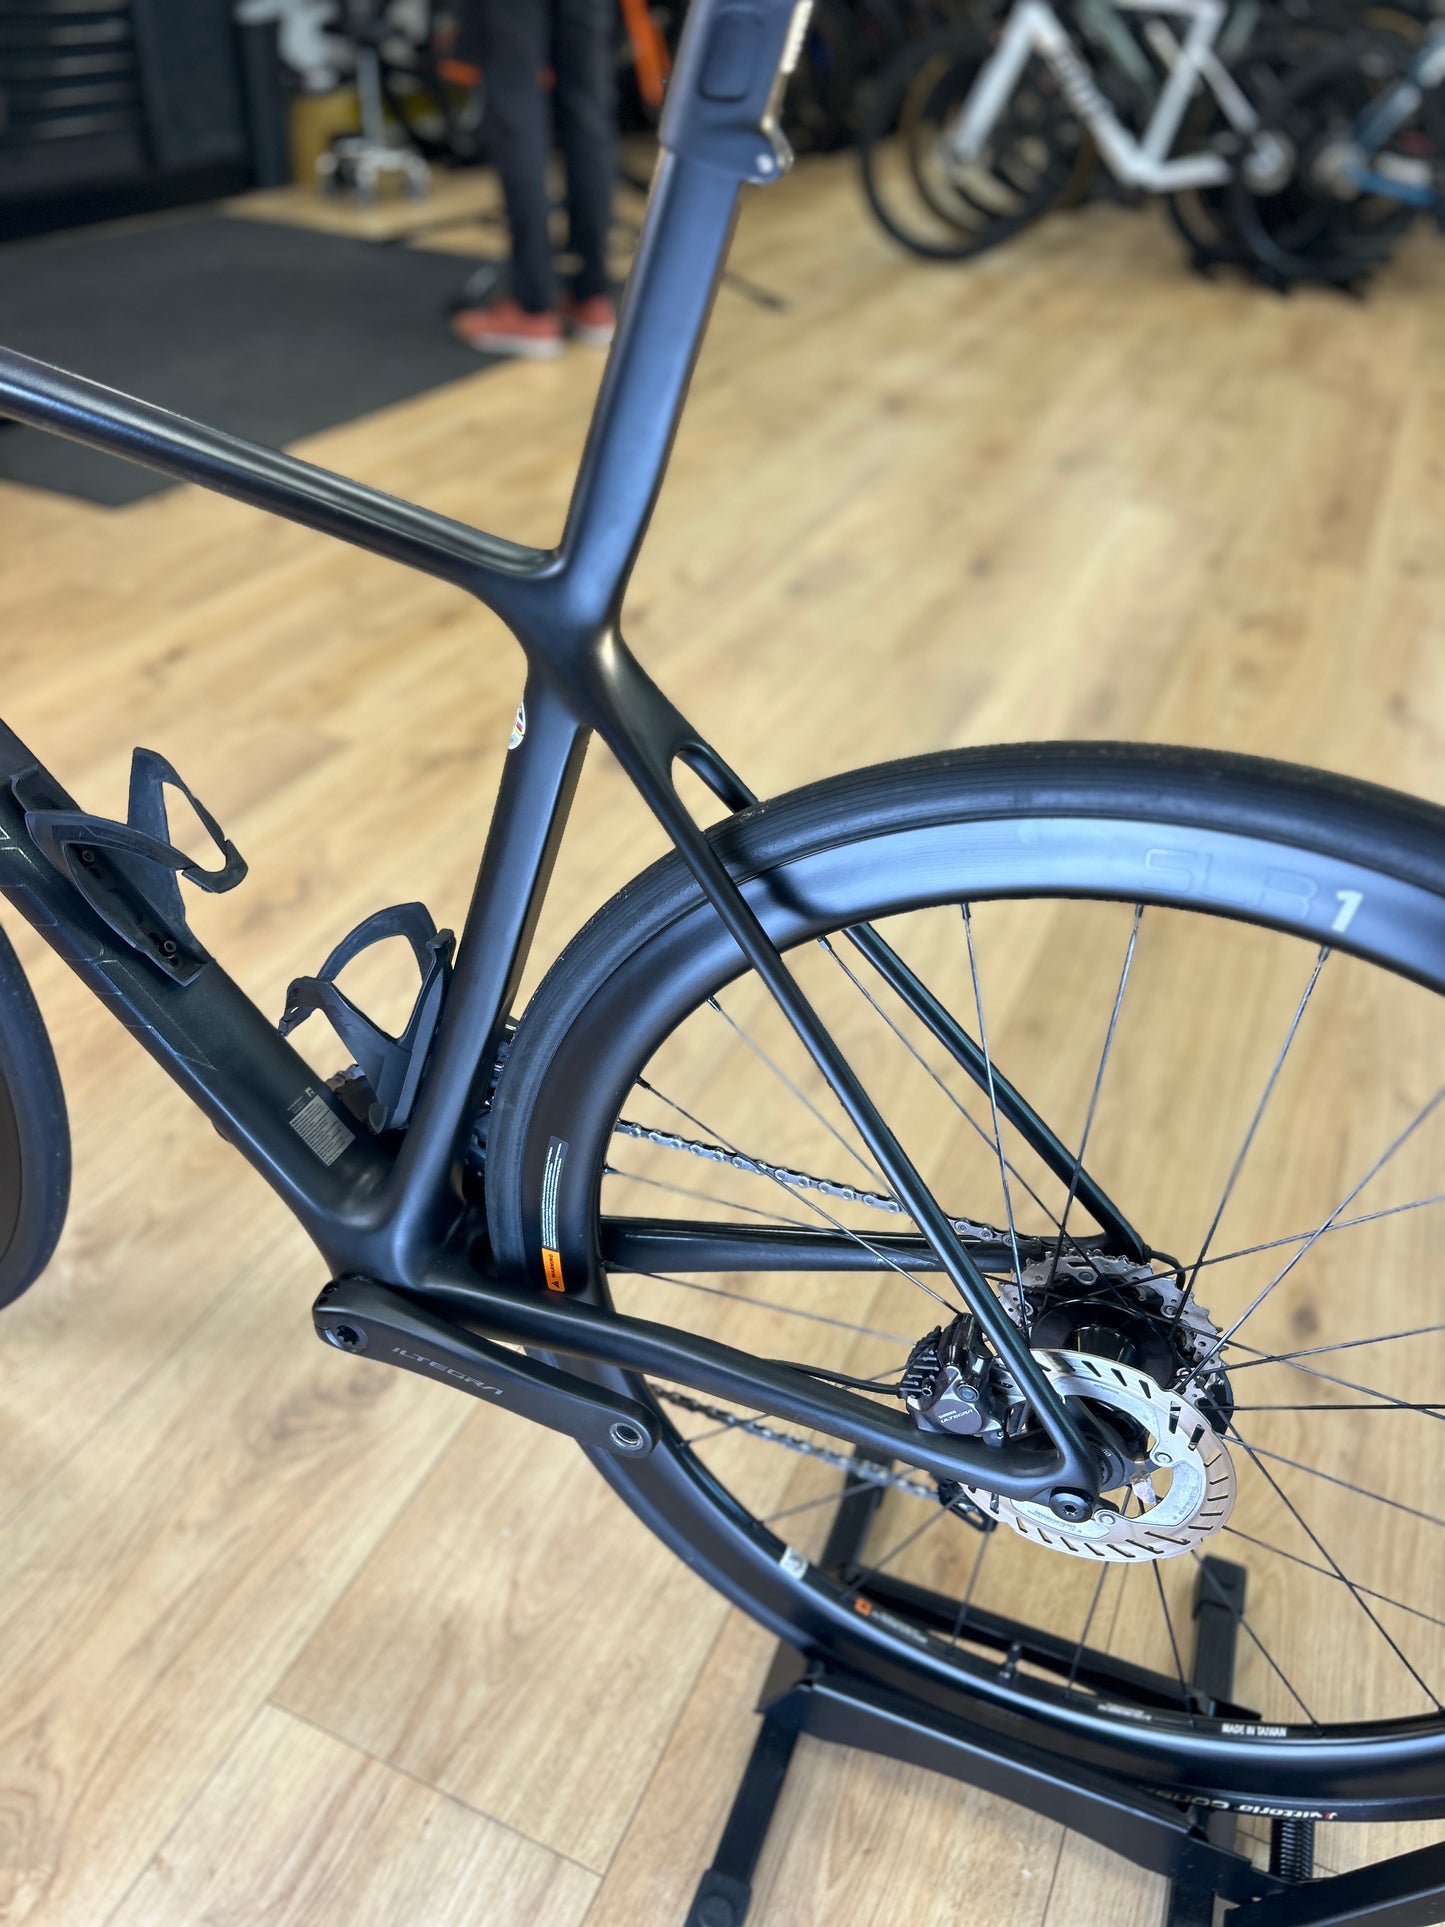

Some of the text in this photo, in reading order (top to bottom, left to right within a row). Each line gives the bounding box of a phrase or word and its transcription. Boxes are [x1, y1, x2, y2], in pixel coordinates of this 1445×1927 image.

[1141, 848, 1363, 933] SLR 1
[1222, 1722, 1287, 1738] MADE IN TAIWAN
